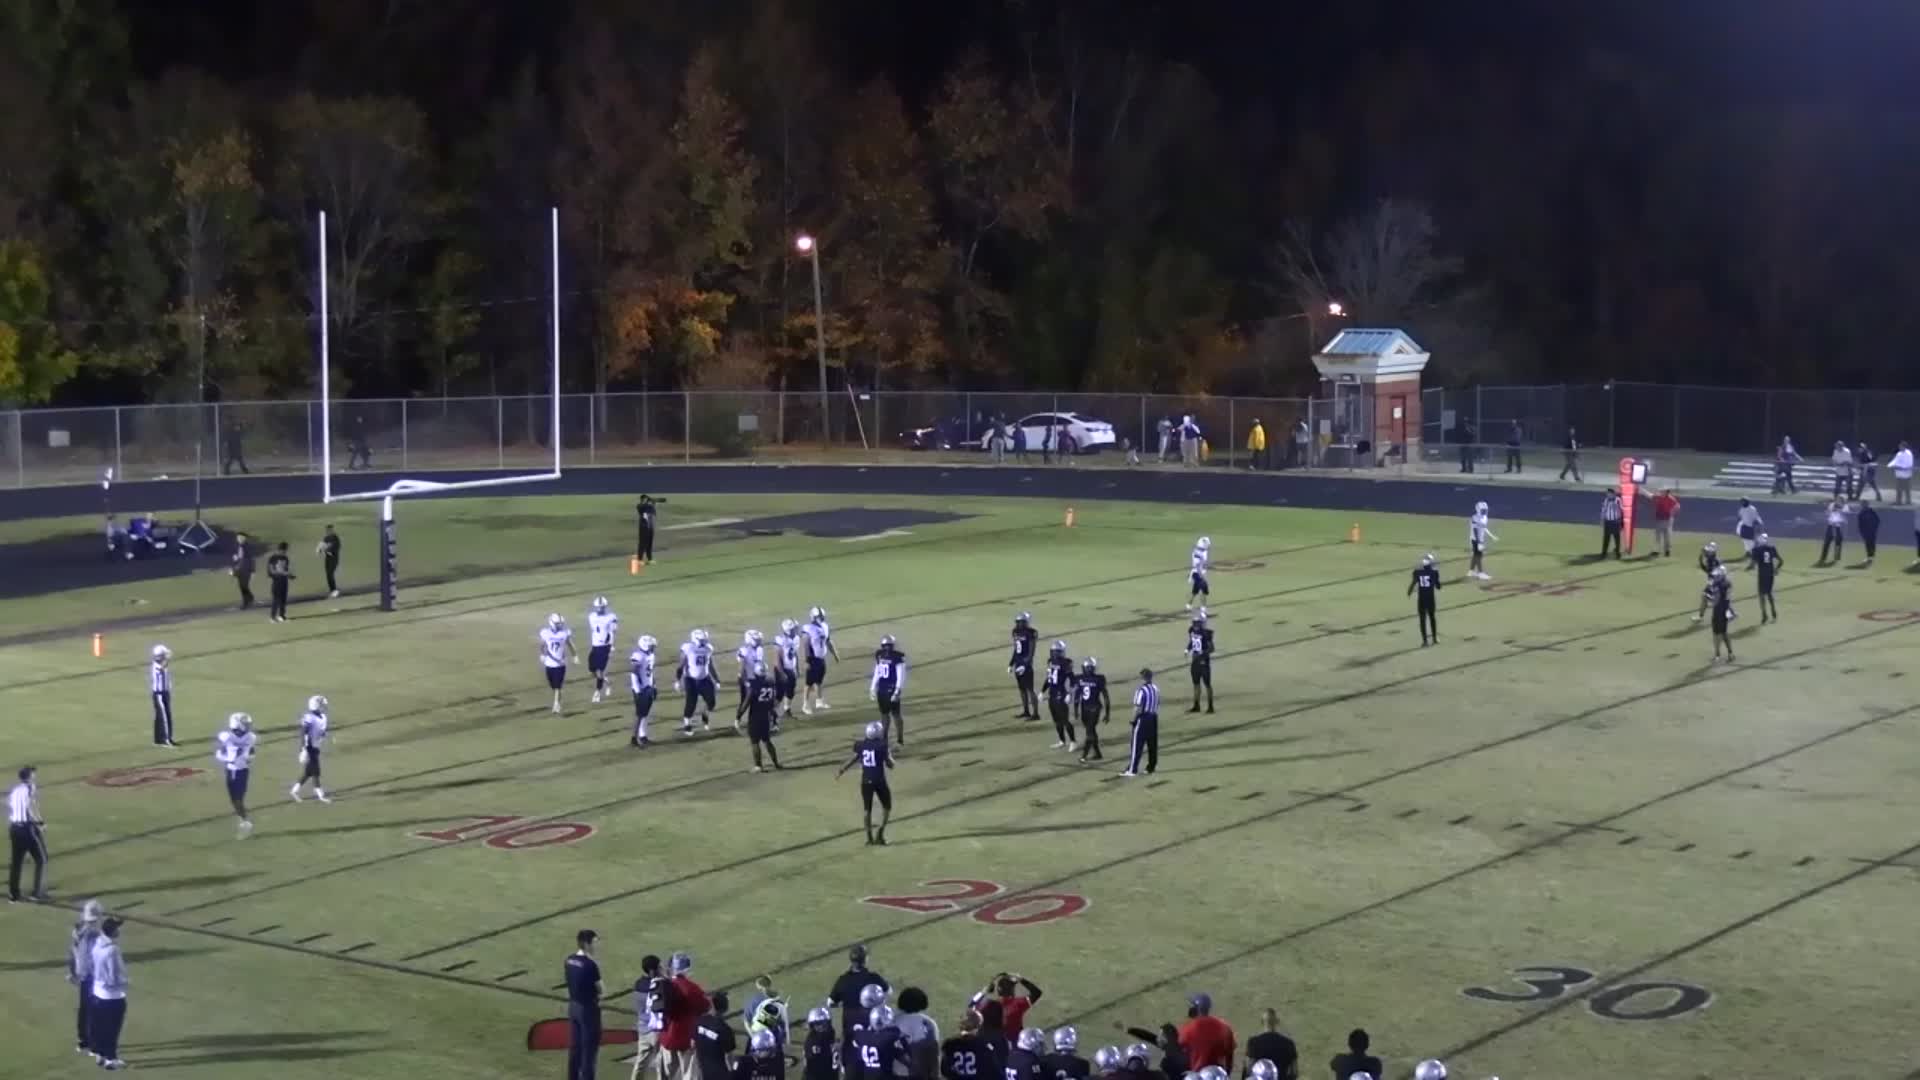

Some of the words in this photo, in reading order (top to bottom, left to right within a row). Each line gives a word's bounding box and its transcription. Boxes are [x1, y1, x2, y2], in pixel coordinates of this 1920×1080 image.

[1419, 575, 1431, 588] 15
[758, 687, 773, 702] 23
[1082, 686, 1091, 701] 9
[862, 750, 876, 767] 21
[408, 815, 595, 849] 10
[860, 879, 1091, 925] 20
[1461, 966, 1714, 1021] 30
[953, 1051, 977, 1075] 22
